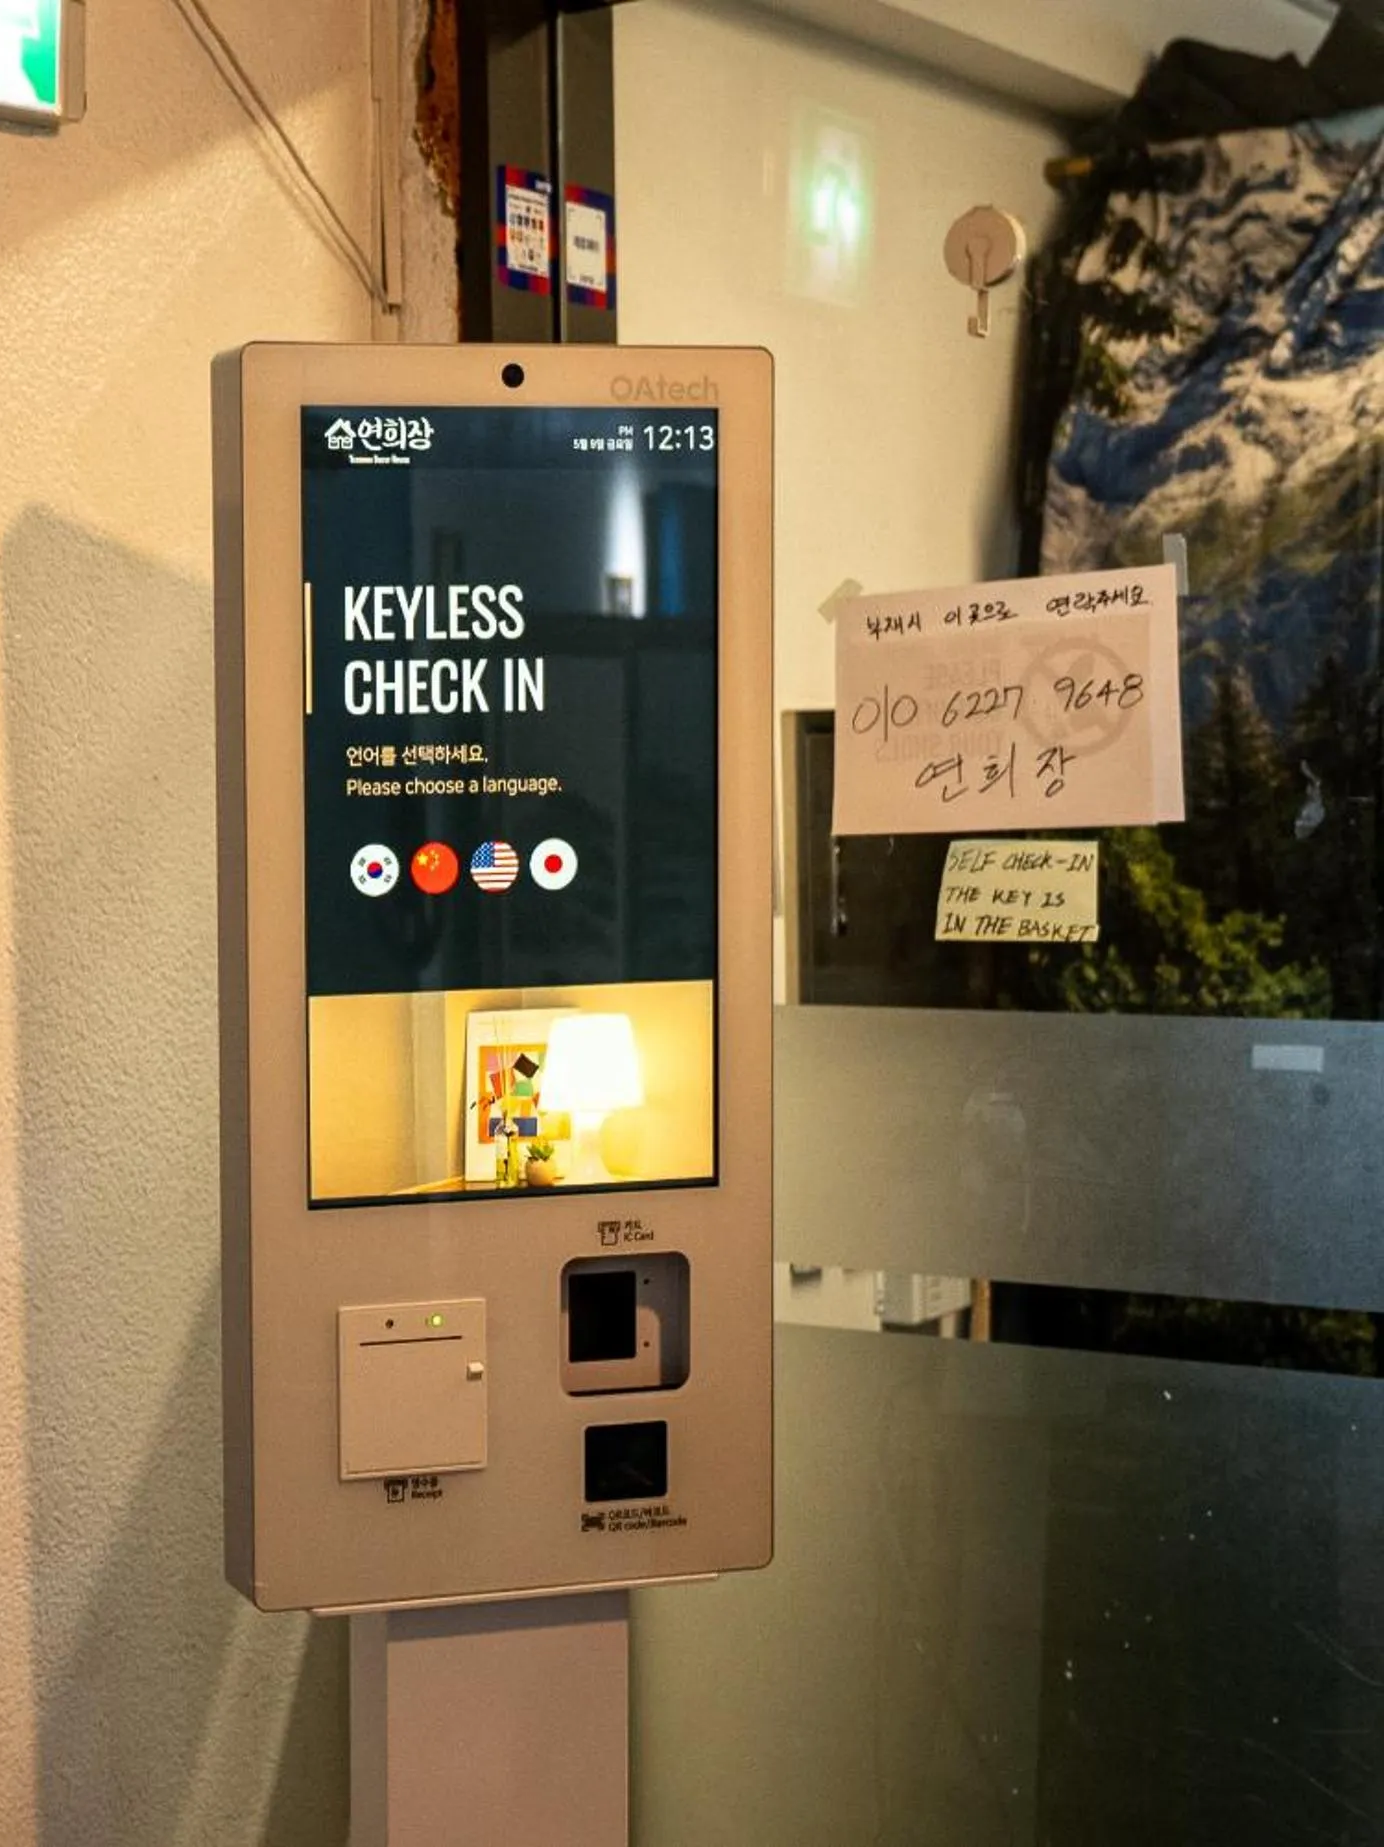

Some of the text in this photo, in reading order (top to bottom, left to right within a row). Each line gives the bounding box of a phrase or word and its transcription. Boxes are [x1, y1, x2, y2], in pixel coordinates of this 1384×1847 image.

[610, 374, 719, 401] OAtech
[357, 416, 435, 451] 연희장
[643, 425, 714, 451] 12:13
[343, 584, 525, 641] KEYLESS
[866, 612, 922, 640] 부재시
[344, 657, 545, 716] CHECK IN
[942, 686, 1025, 728] 6227
[1054, 673, 1144, 712] 9648
[346, 744, 489, 767] 언어를 선택하세요.
[346, 776, 562, 796] Please choose a language.
[947, 849, 1094, 873] SELF CHECK-IN
[945, 886, 1066, 908] THE KEY IS
[942, 912, 1095, 942] IN THE BASKET
